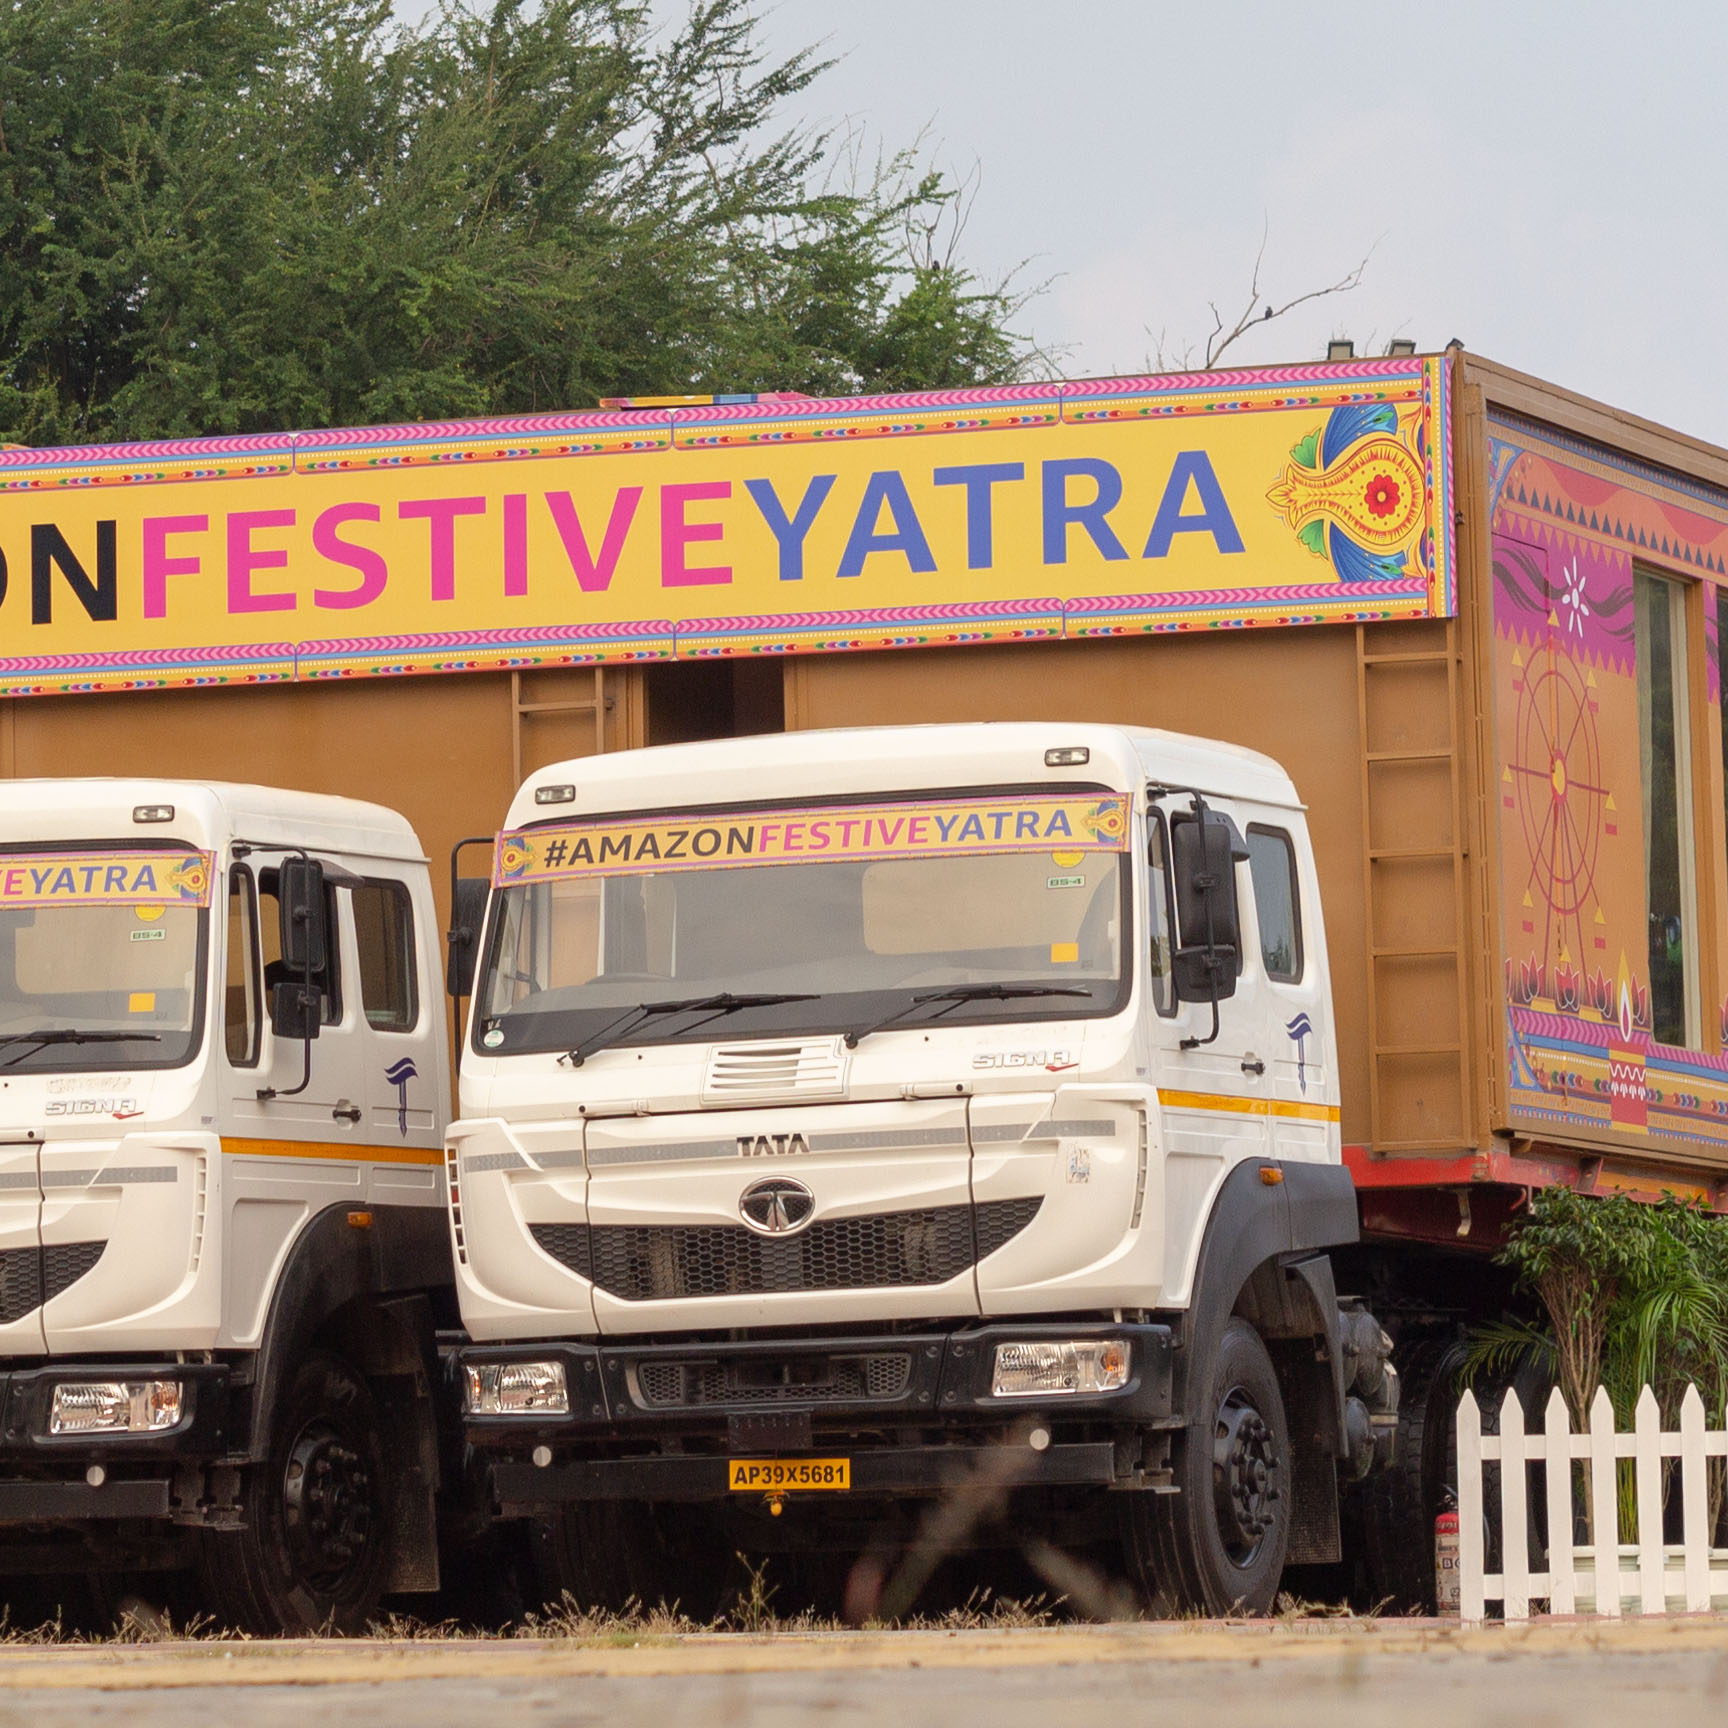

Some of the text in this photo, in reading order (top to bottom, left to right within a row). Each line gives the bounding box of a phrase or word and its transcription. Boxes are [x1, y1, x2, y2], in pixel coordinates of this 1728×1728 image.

[545, 809, 1073, 868] #AMAZONFESTIVEYATRA
[973, 1050, 1069, 1069] SIGNA
[45, 1098, 137, 1116] SIGNA
[736, 1133, 810, 1156] TATA
[734, 1465, 844, 1484] AP39X5681
